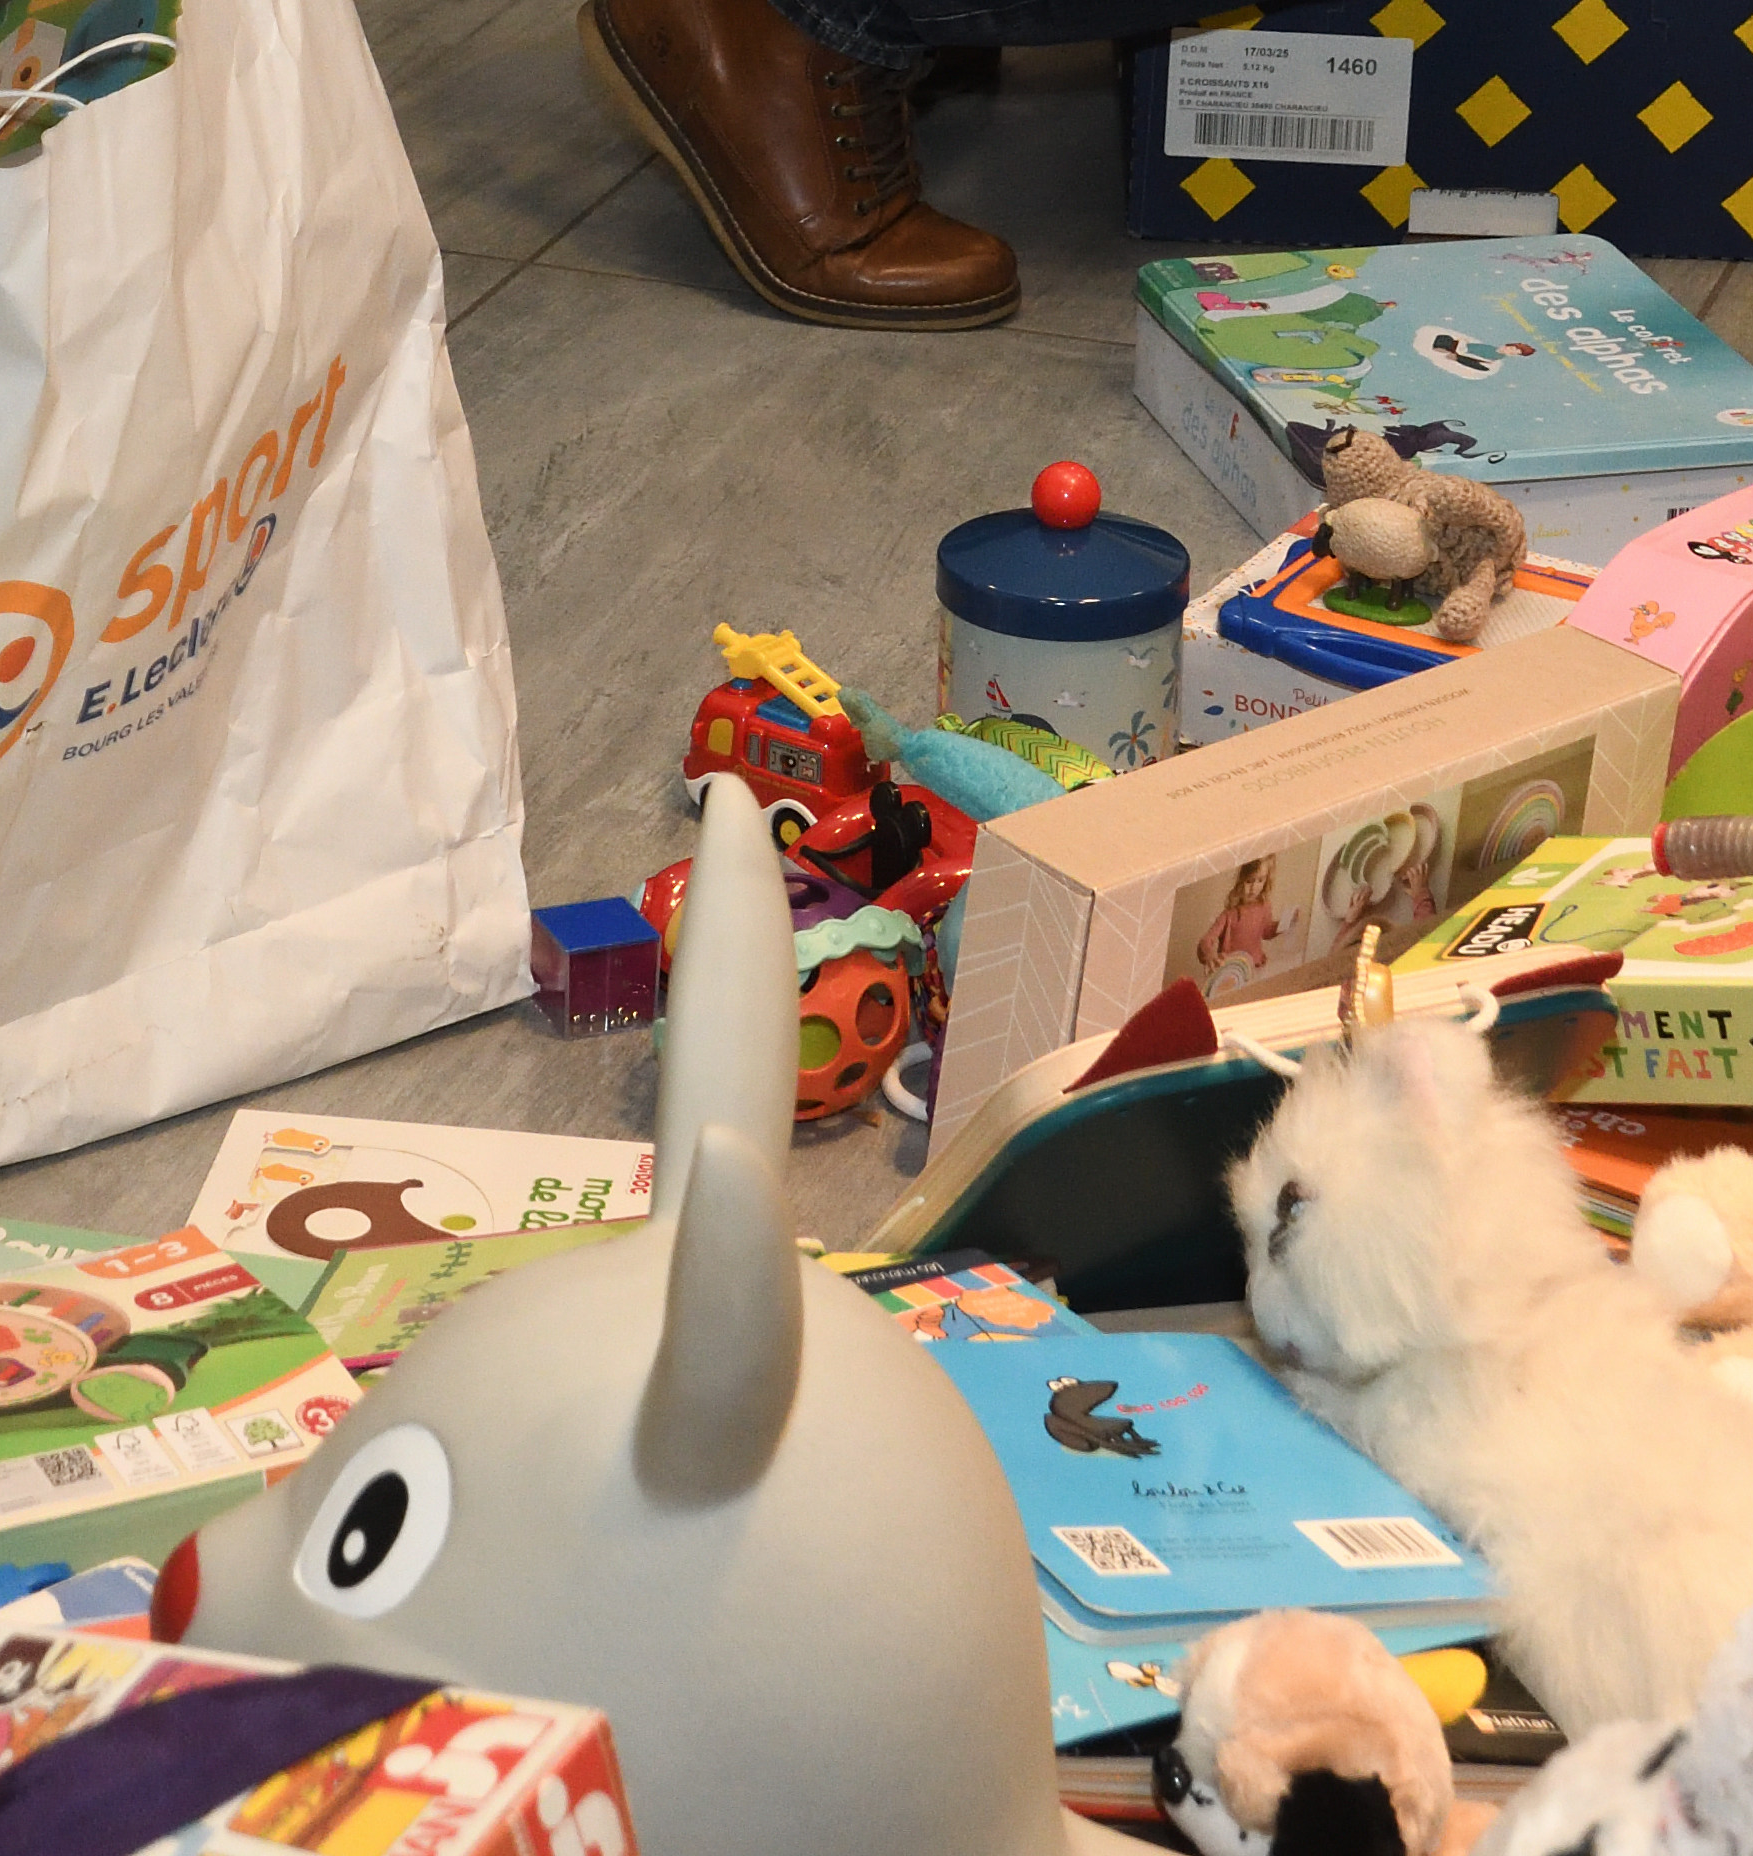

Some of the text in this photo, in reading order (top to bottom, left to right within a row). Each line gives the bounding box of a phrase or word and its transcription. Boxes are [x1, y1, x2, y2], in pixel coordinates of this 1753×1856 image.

[1244, 47, 1290, 58] 17/03/25
[1326, 56, 1378, 76] 1460
[1187, 78, 1251, 89] CROISSANTS
[1609, 308, 1637, 324] Le
[1519, 277, 1583, 322] des
[1565, 325, 1669, 395] alphas
[98, 353, 346, 643] sport
[62, 723, 133, 761] BOURG
[136, 703, 165, 731] LES
[1458, 906, 1537, 955] HEADU
[1622, 1009, 1732, 1040] MENT
[1645, 1047, 1738, 1080] FAIT
[529, 1177, 573, 1203] de
[150, 1291, 174, 1307] 8
